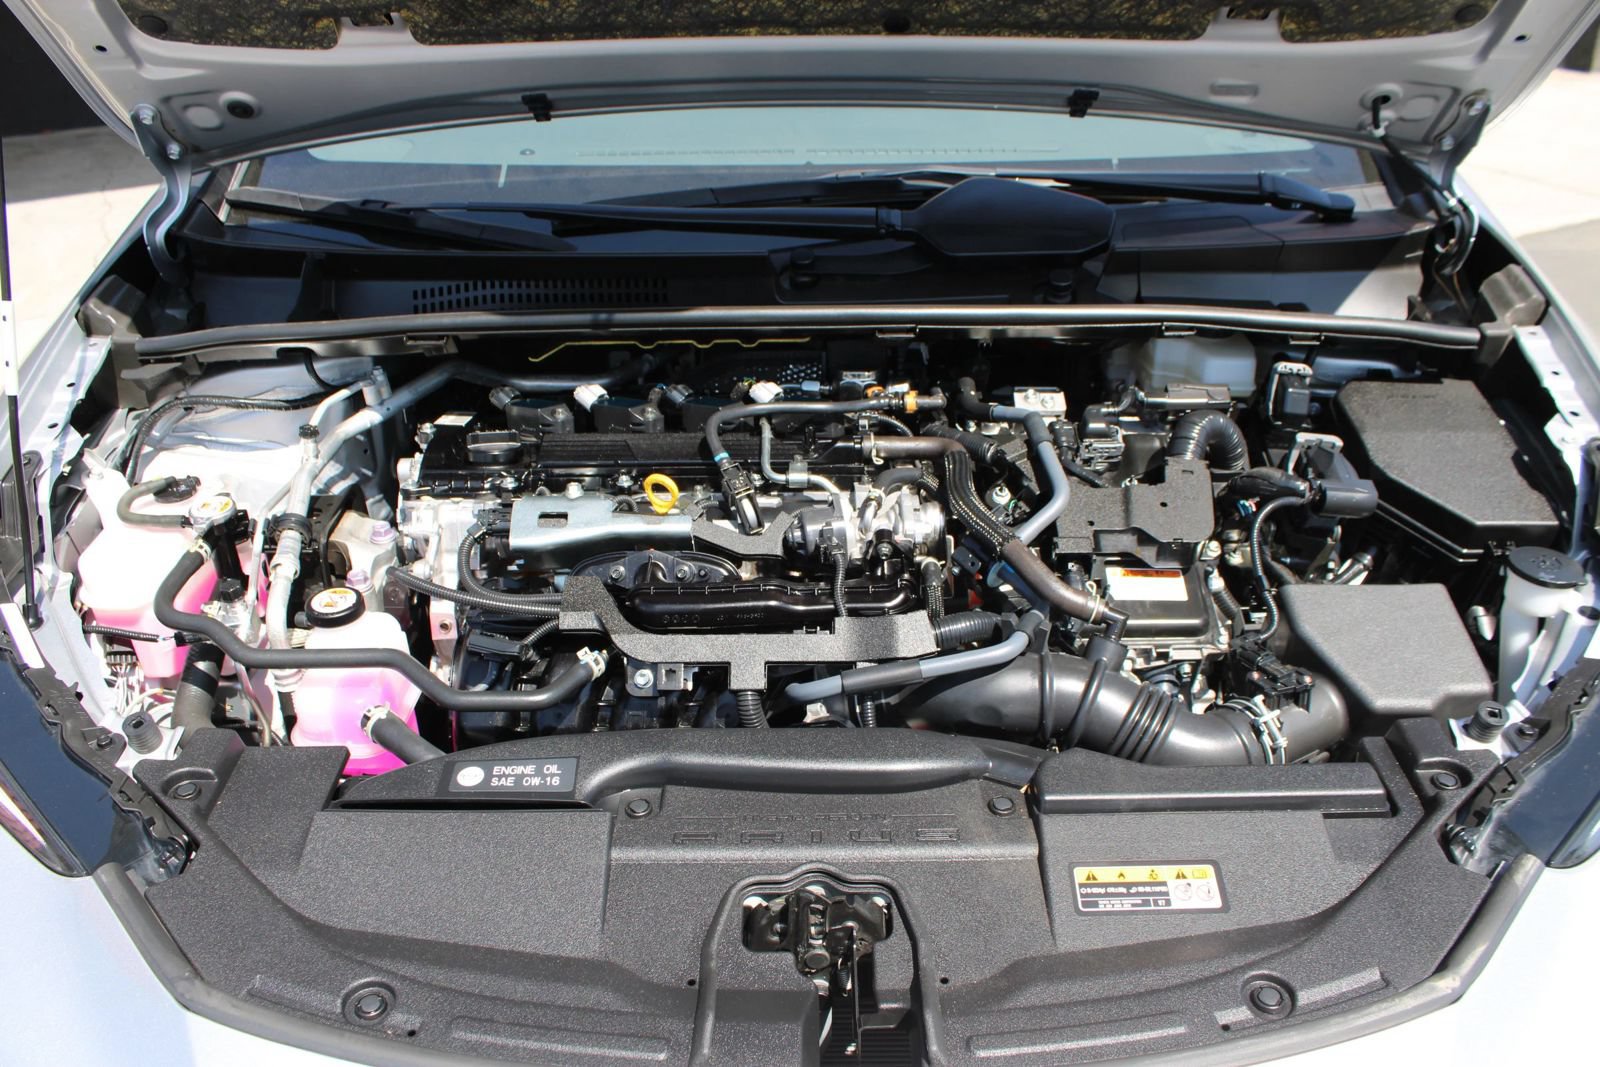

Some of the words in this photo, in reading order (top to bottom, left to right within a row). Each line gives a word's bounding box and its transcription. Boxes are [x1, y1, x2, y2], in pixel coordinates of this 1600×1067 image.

[492, 765, 536, 775] ENGINE
[543, 764, 562, 774] OIL
[490, 776, 515, 786] SAE
[522, 776, 560, 786] 0W-16
[672, 828, 960, 843] PRIUS
